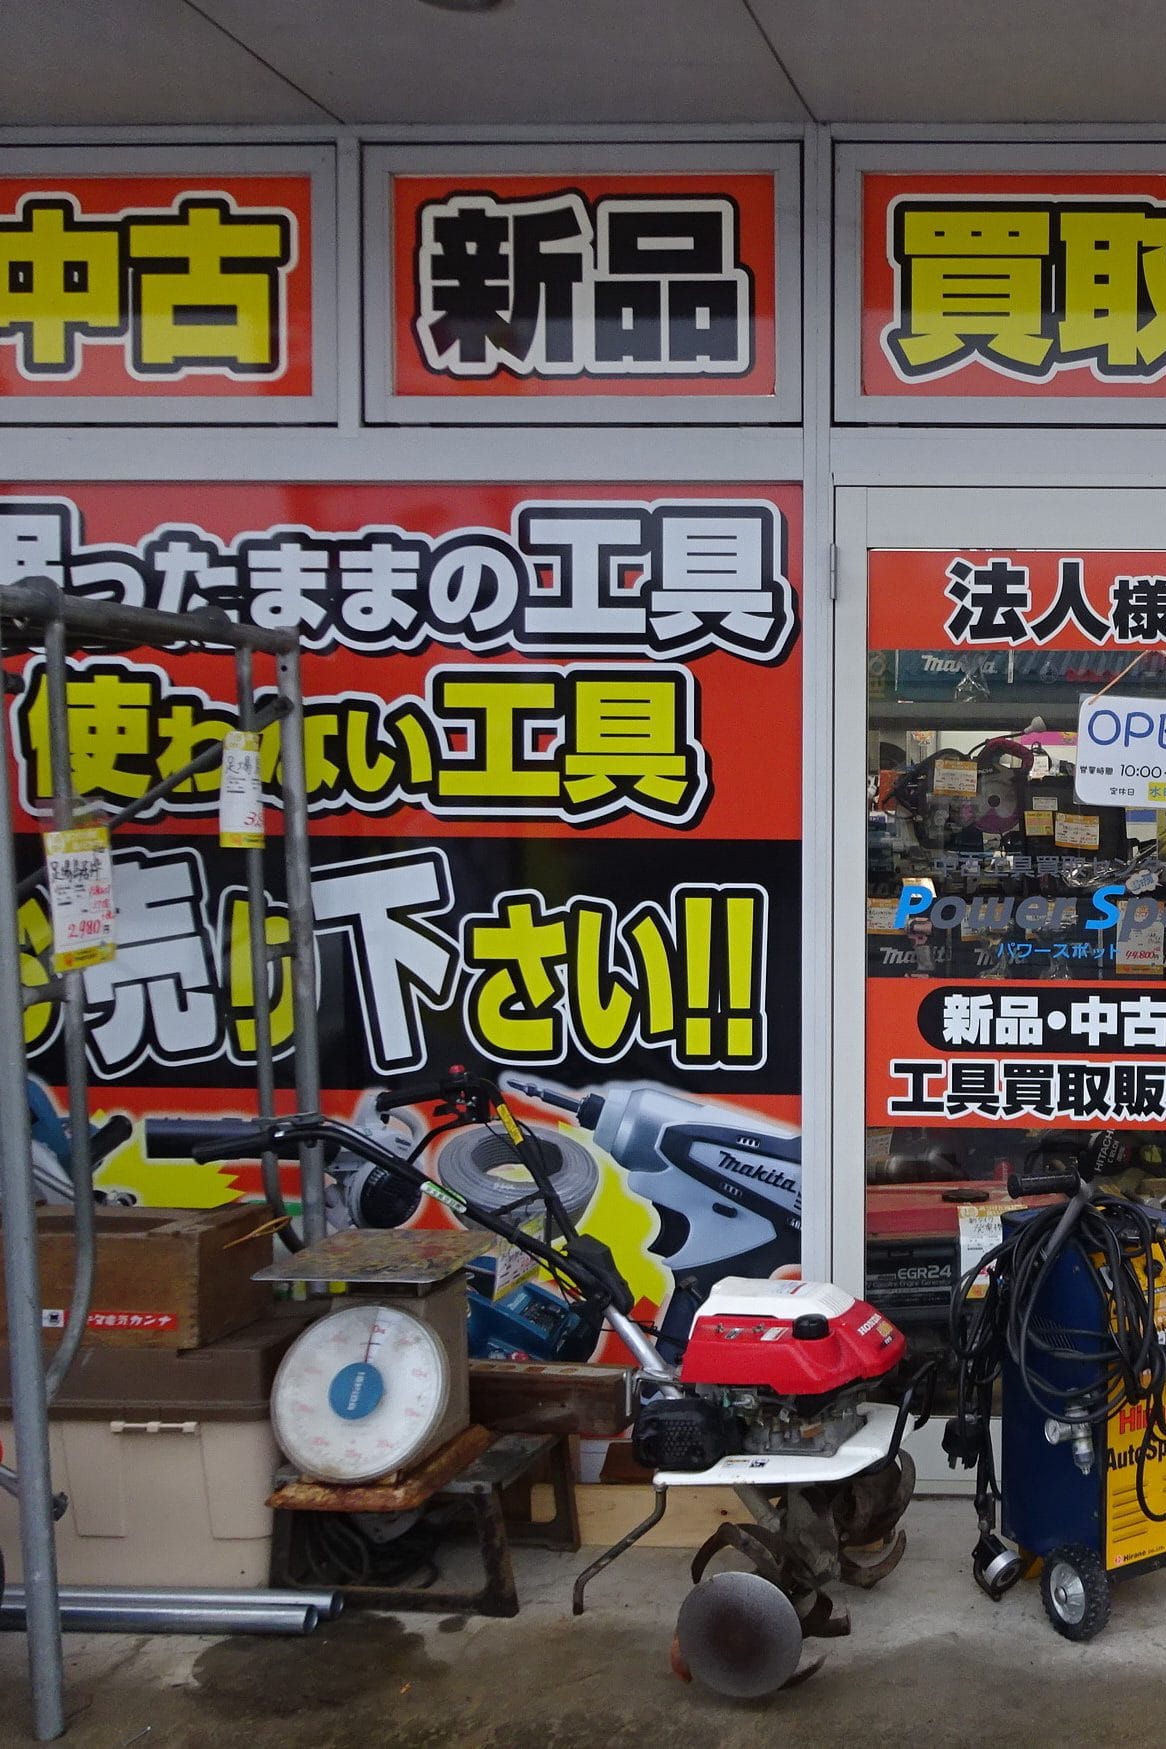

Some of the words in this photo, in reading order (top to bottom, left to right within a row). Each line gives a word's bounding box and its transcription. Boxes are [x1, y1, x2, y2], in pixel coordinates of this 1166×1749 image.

[0, 194, 294, 380] 中古
[420, 194, 754, 374] 新品
[892, 885, 1078, 930] Power
[996, 942, 1122, 961] パワースポット
[1095, 1128, 1115, 1172] HITACH
